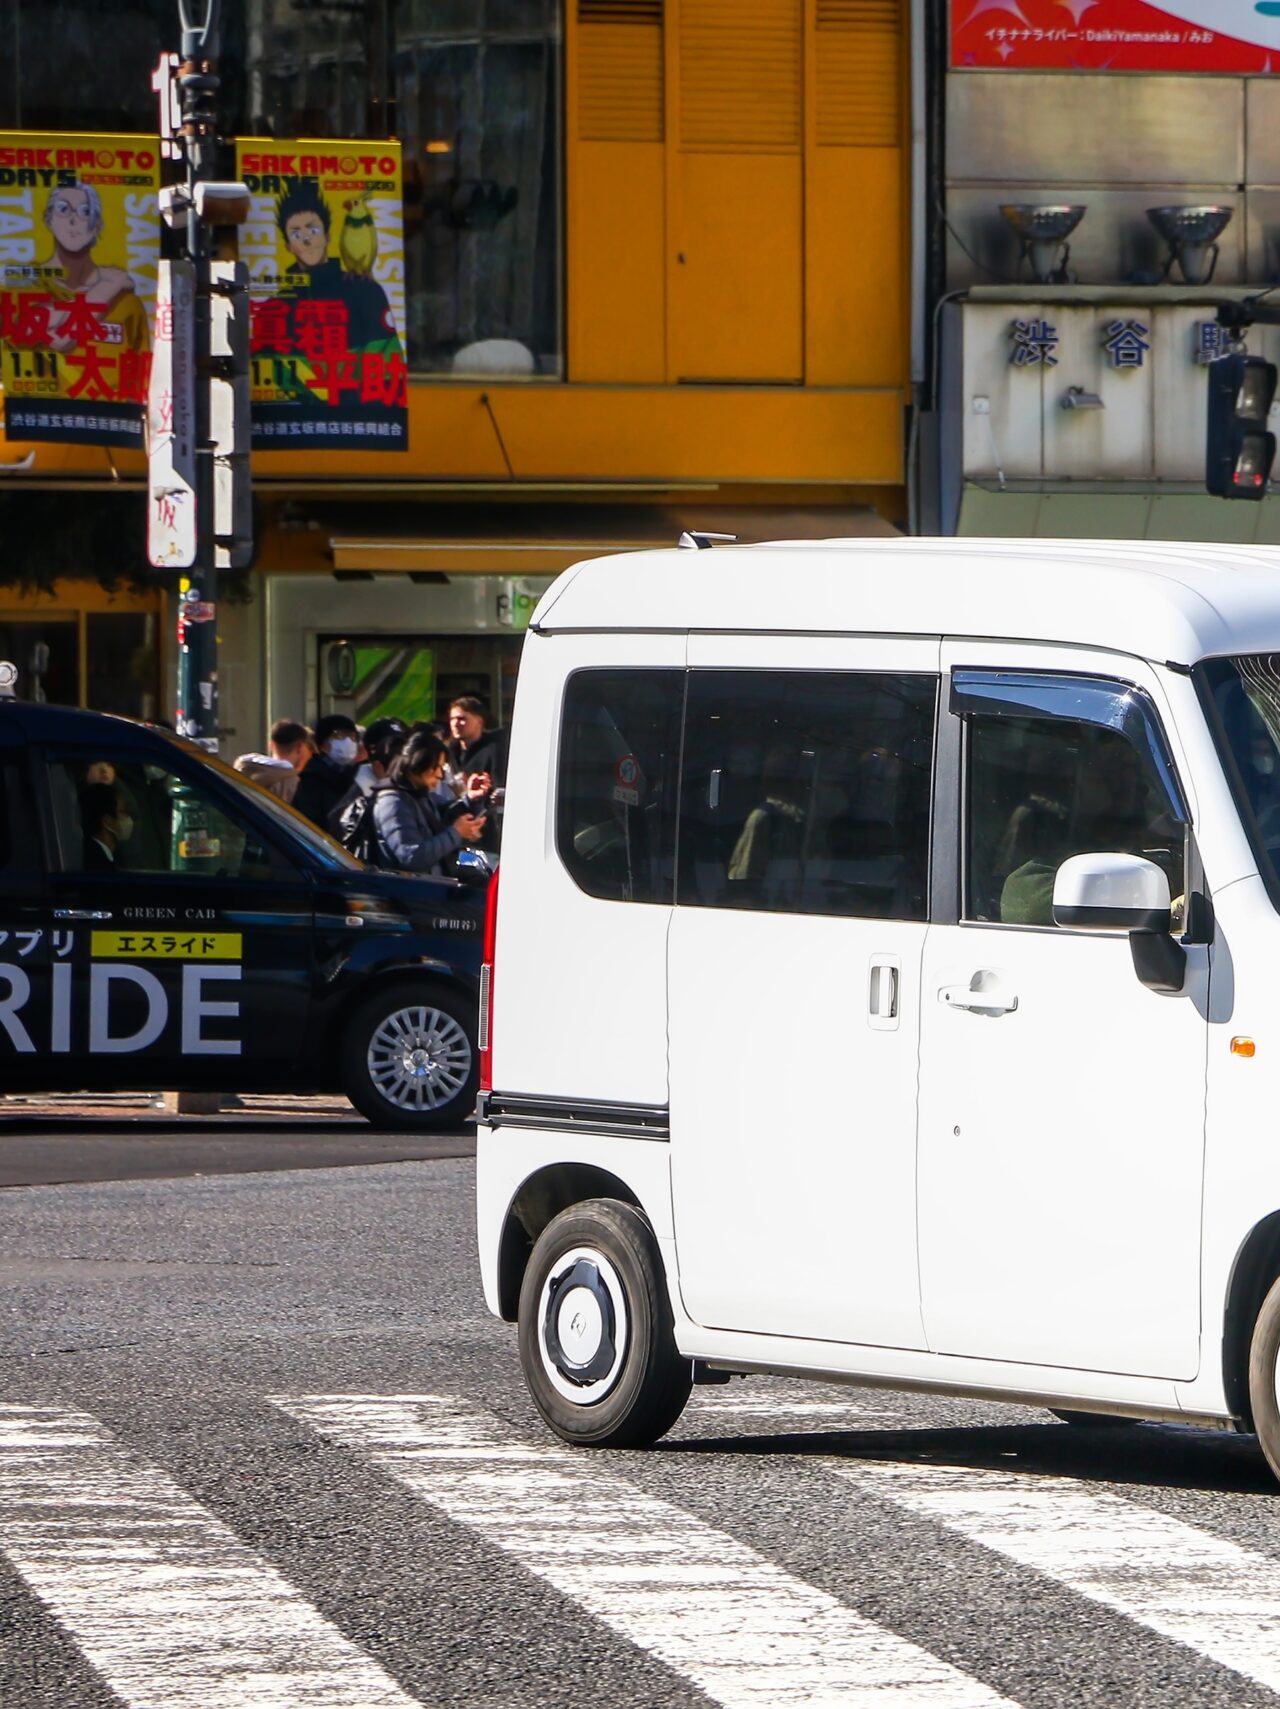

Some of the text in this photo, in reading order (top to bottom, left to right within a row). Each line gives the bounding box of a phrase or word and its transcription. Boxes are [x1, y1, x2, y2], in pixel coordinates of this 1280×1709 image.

[0, 148, 154, 170] SAKAMOTO
[241, 154, 396, 175] SAKAMOTO
[0, 169, 76, 187] DAYS
[0, 292, 109, 349] 坂本
[11, 352, 59, 379] 1.11
[251, 360, 298, 387] 1.11
[304, 353, 409, 407] 平助
[122, 907, 217, 919] GREEN CAB
[117, 936, 216, 954] エスライド
[0, 962, 242, 1055] RIDE
